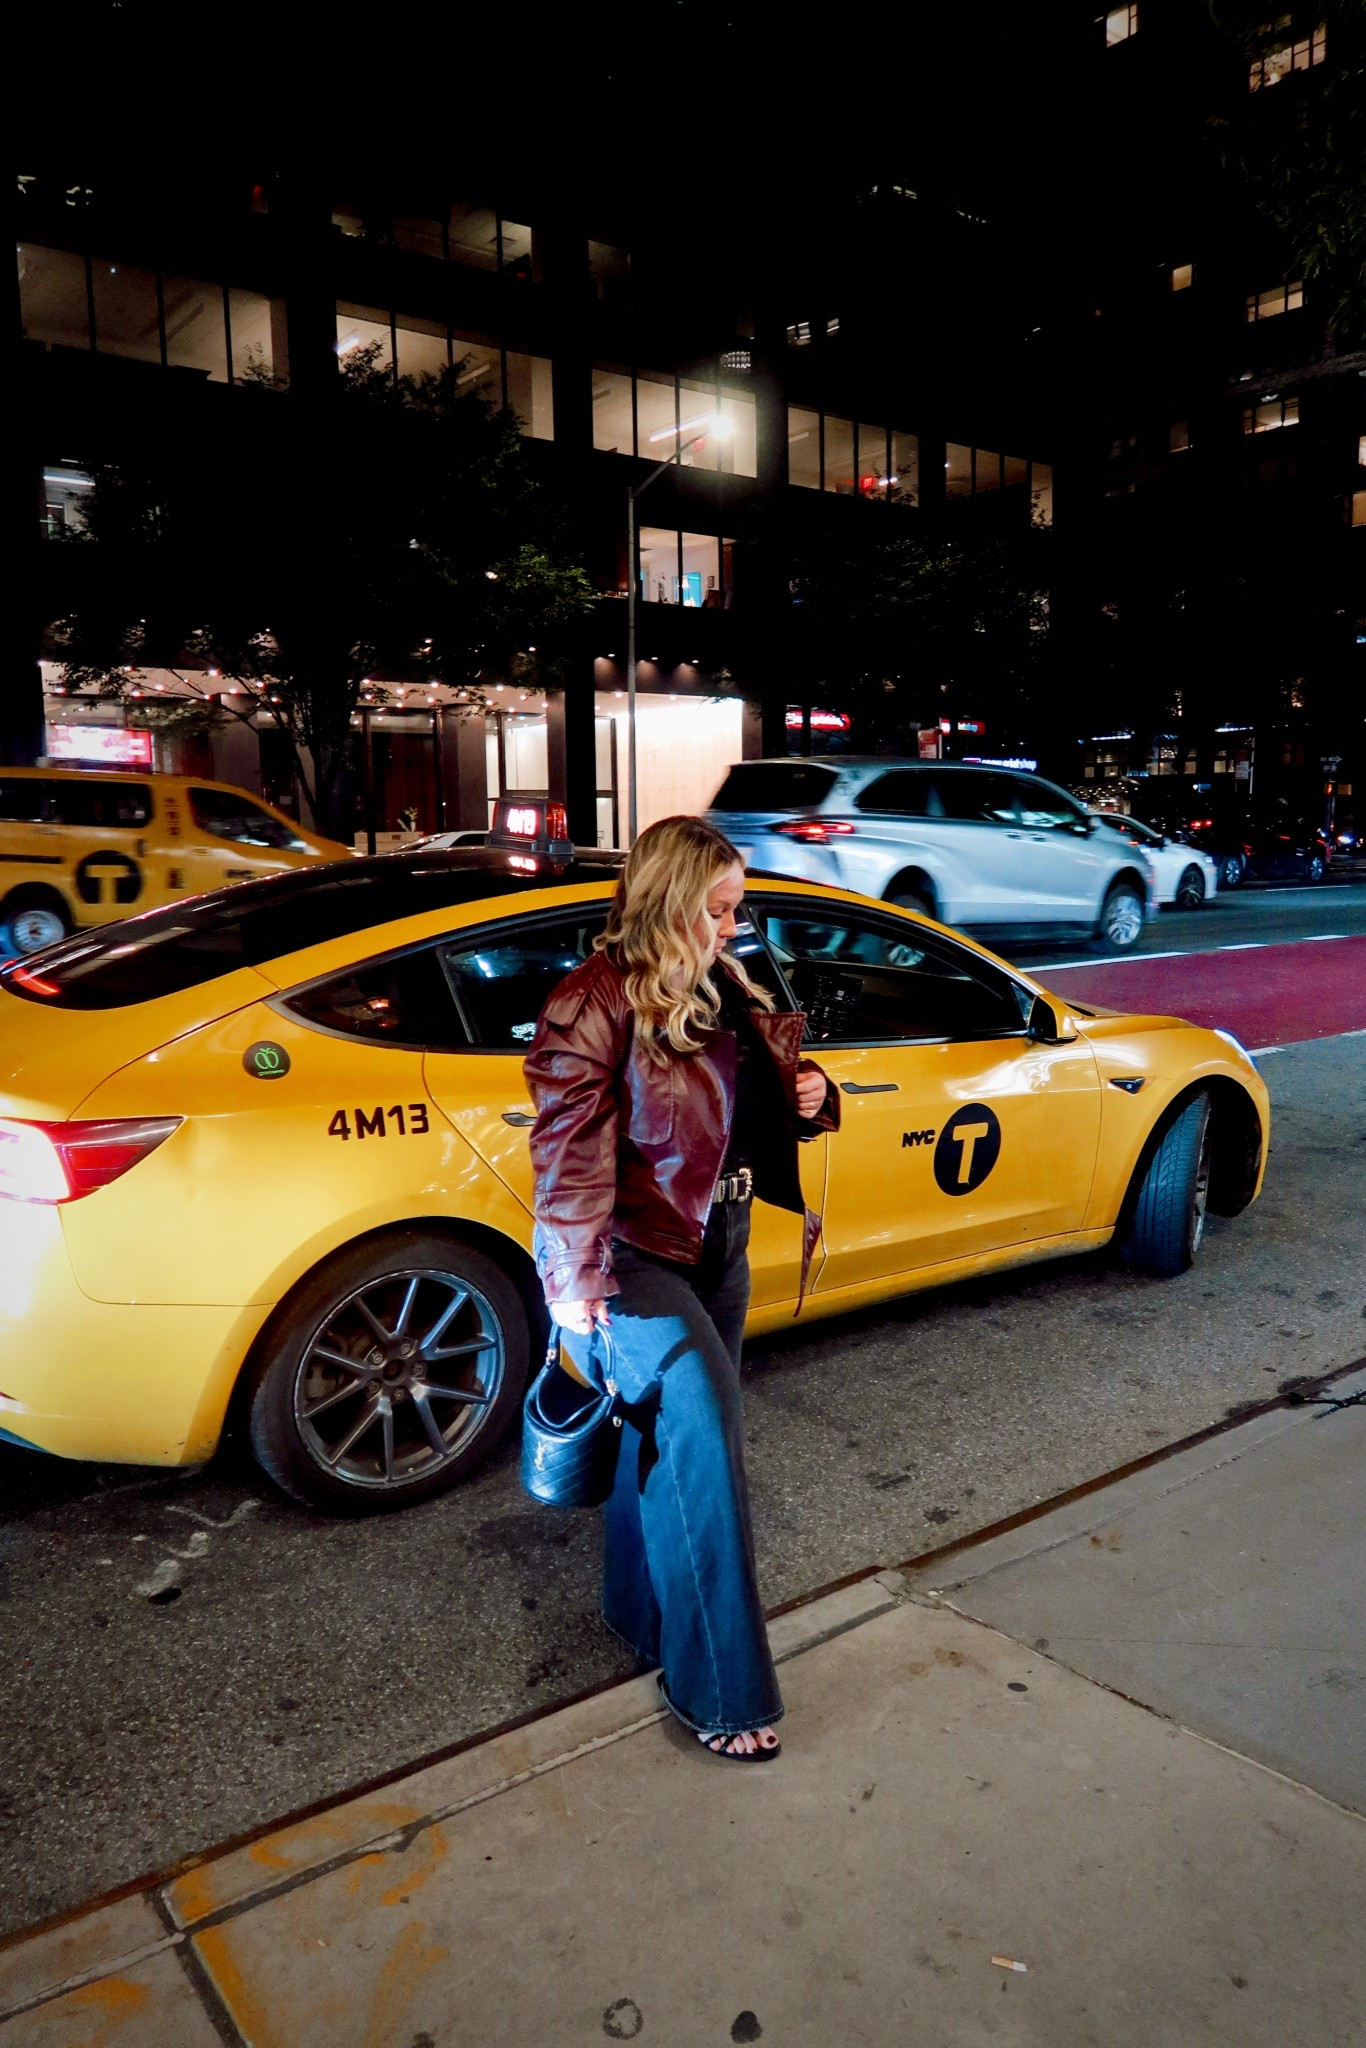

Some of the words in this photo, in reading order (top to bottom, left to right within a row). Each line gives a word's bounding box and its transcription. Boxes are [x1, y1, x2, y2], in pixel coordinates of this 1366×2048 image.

[327, 1103, 430, 1141] 4M13
[901, 1128, 936, 1149] NYC
[952, 1121, 989, 1185] T
